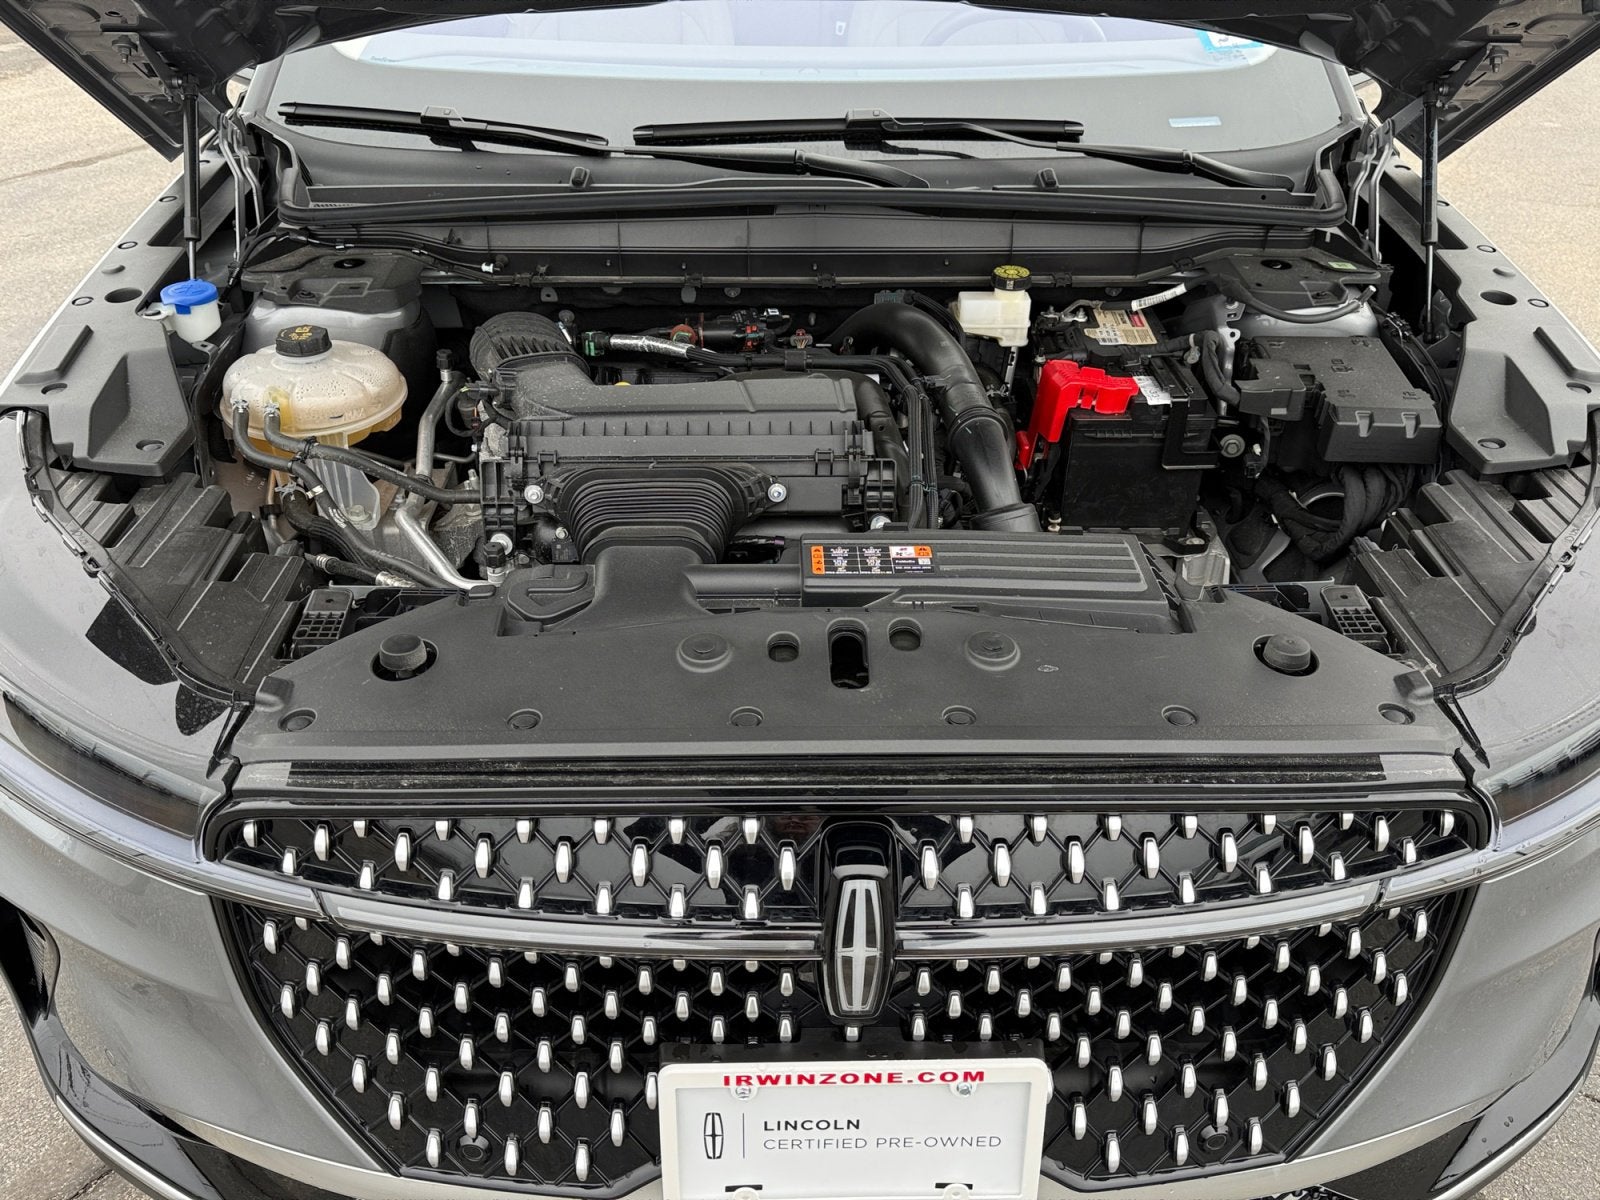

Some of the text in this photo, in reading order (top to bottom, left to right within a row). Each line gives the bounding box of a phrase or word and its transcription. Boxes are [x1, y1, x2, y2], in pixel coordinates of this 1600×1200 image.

[724, 1071, 985, 1087] IRWINZONE.COM
[763, 1119, 860, 1132] LINCOLN
[763, 1136, 1002, 1150] CERTIFIED PRE-OWNED
